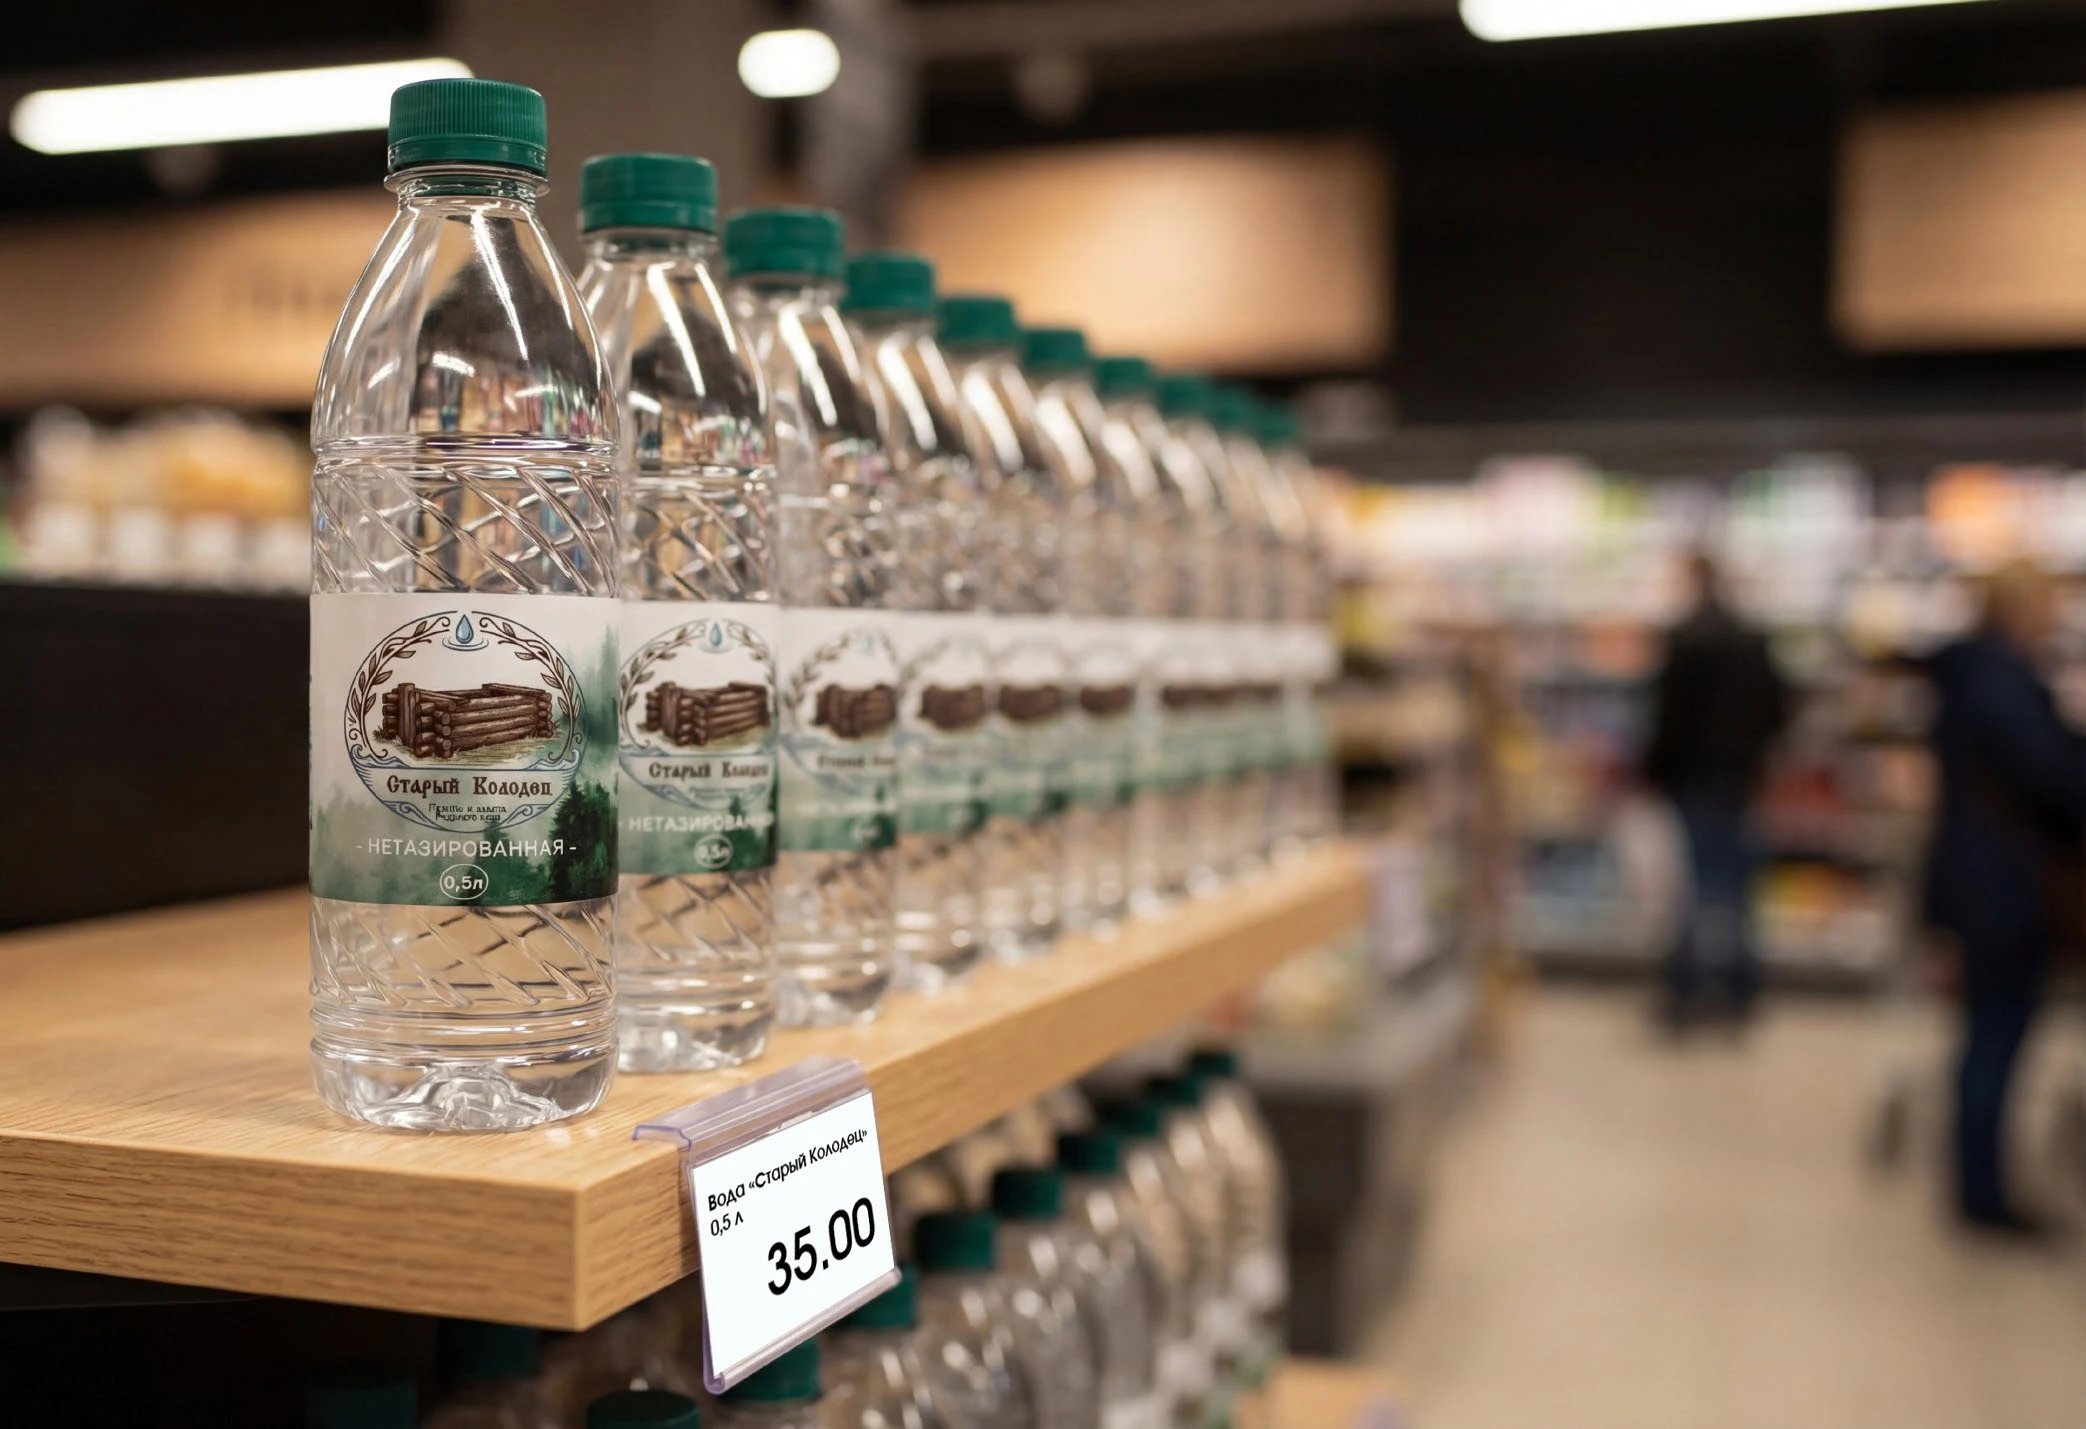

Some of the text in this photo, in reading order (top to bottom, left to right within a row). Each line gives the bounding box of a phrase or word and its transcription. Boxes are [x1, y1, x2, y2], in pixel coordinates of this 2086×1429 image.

[387, 775, 553, 799] Старый Колодец
[443, 875, 483, 893] 0,5л
[707, 1128, 868, 1212] Вода «Старый Колодец»
[710, 1213, 732, 1237] 0,5
[767, 1196, 876, 1296] 35.00
